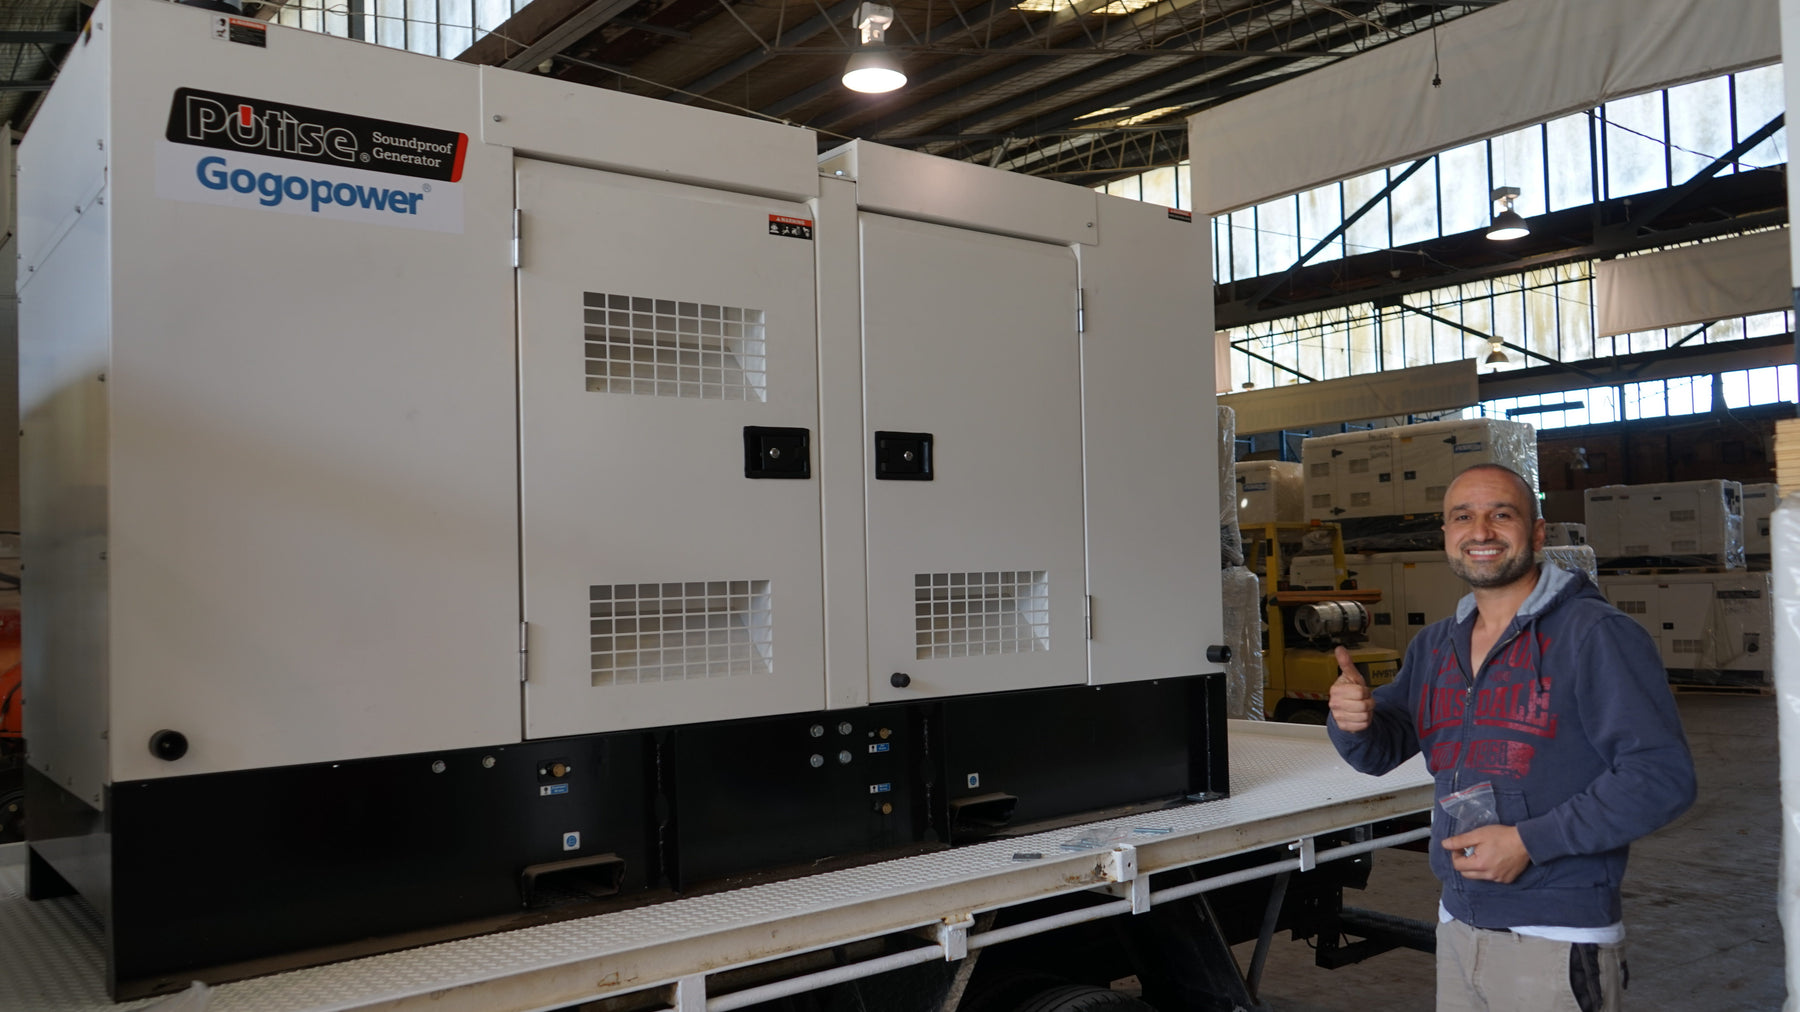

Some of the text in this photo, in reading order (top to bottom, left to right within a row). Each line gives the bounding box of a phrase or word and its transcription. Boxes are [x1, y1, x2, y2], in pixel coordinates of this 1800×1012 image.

[372, 131, 453, 155] Soundproof
[372, 147, 442, 168] Generator
[196, 155, 424, 215] Gogopower
